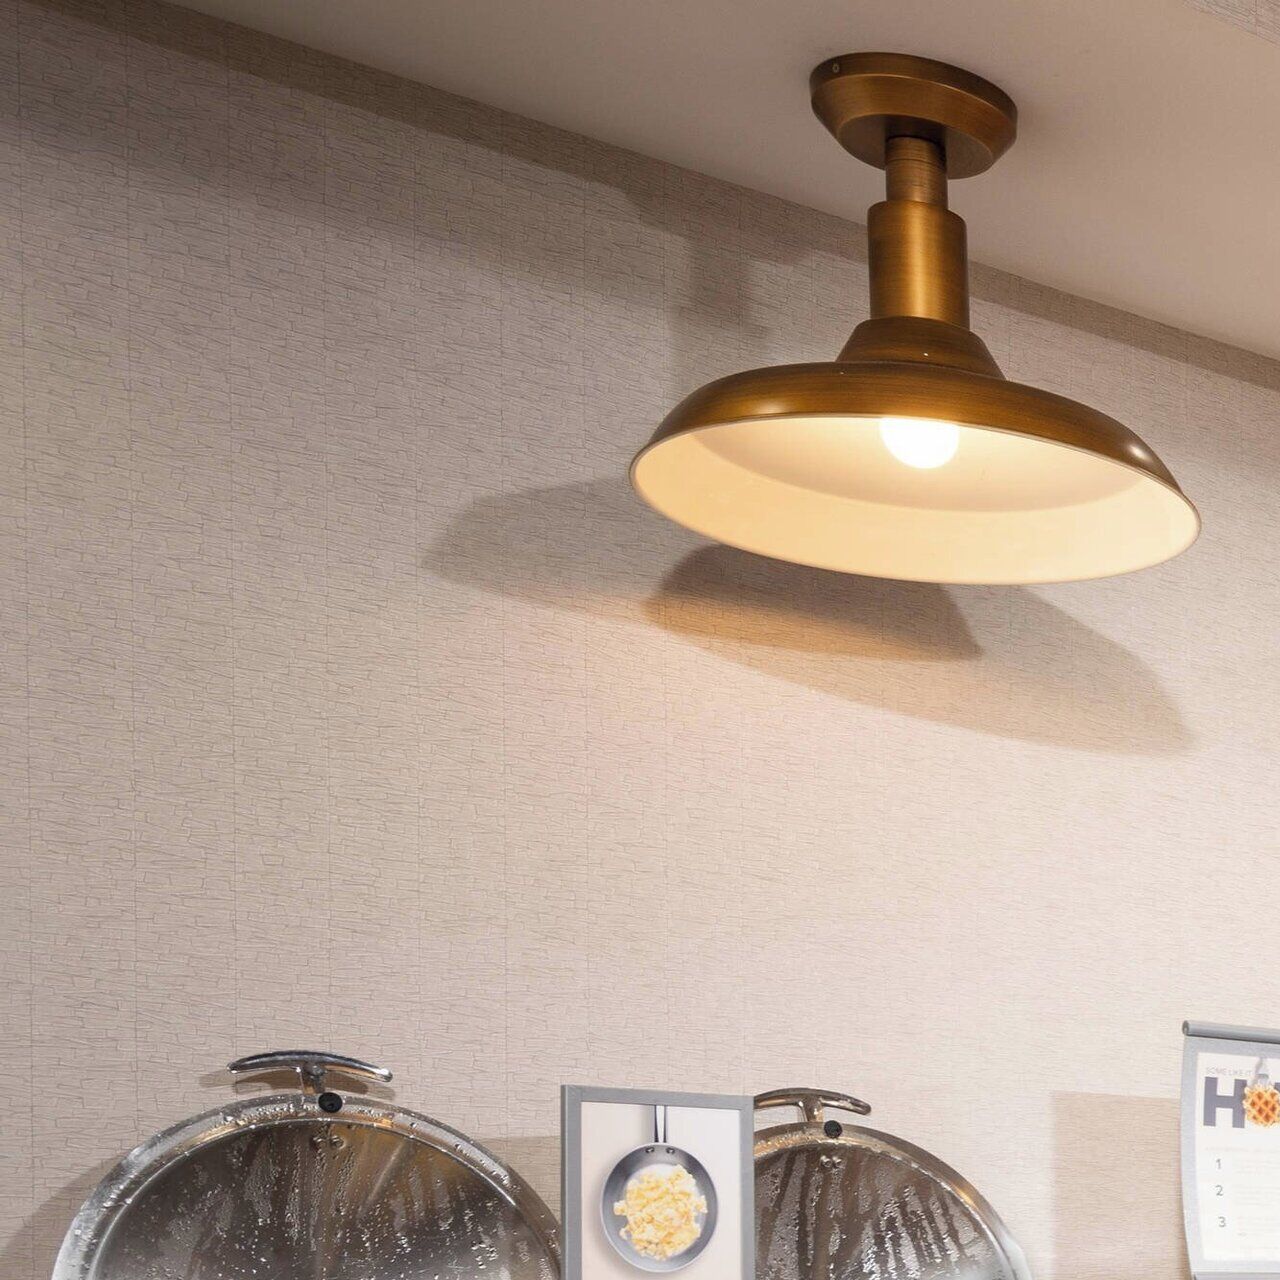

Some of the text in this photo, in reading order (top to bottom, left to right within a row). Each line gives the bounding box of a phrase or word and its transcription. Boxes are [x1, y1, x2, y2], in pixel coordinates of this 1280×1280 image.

[1216, 1158, 1221, 1169] 1
[1215, 1184, 1223, 1196] 2
[1218, 1216, 1226, 1228] 3
